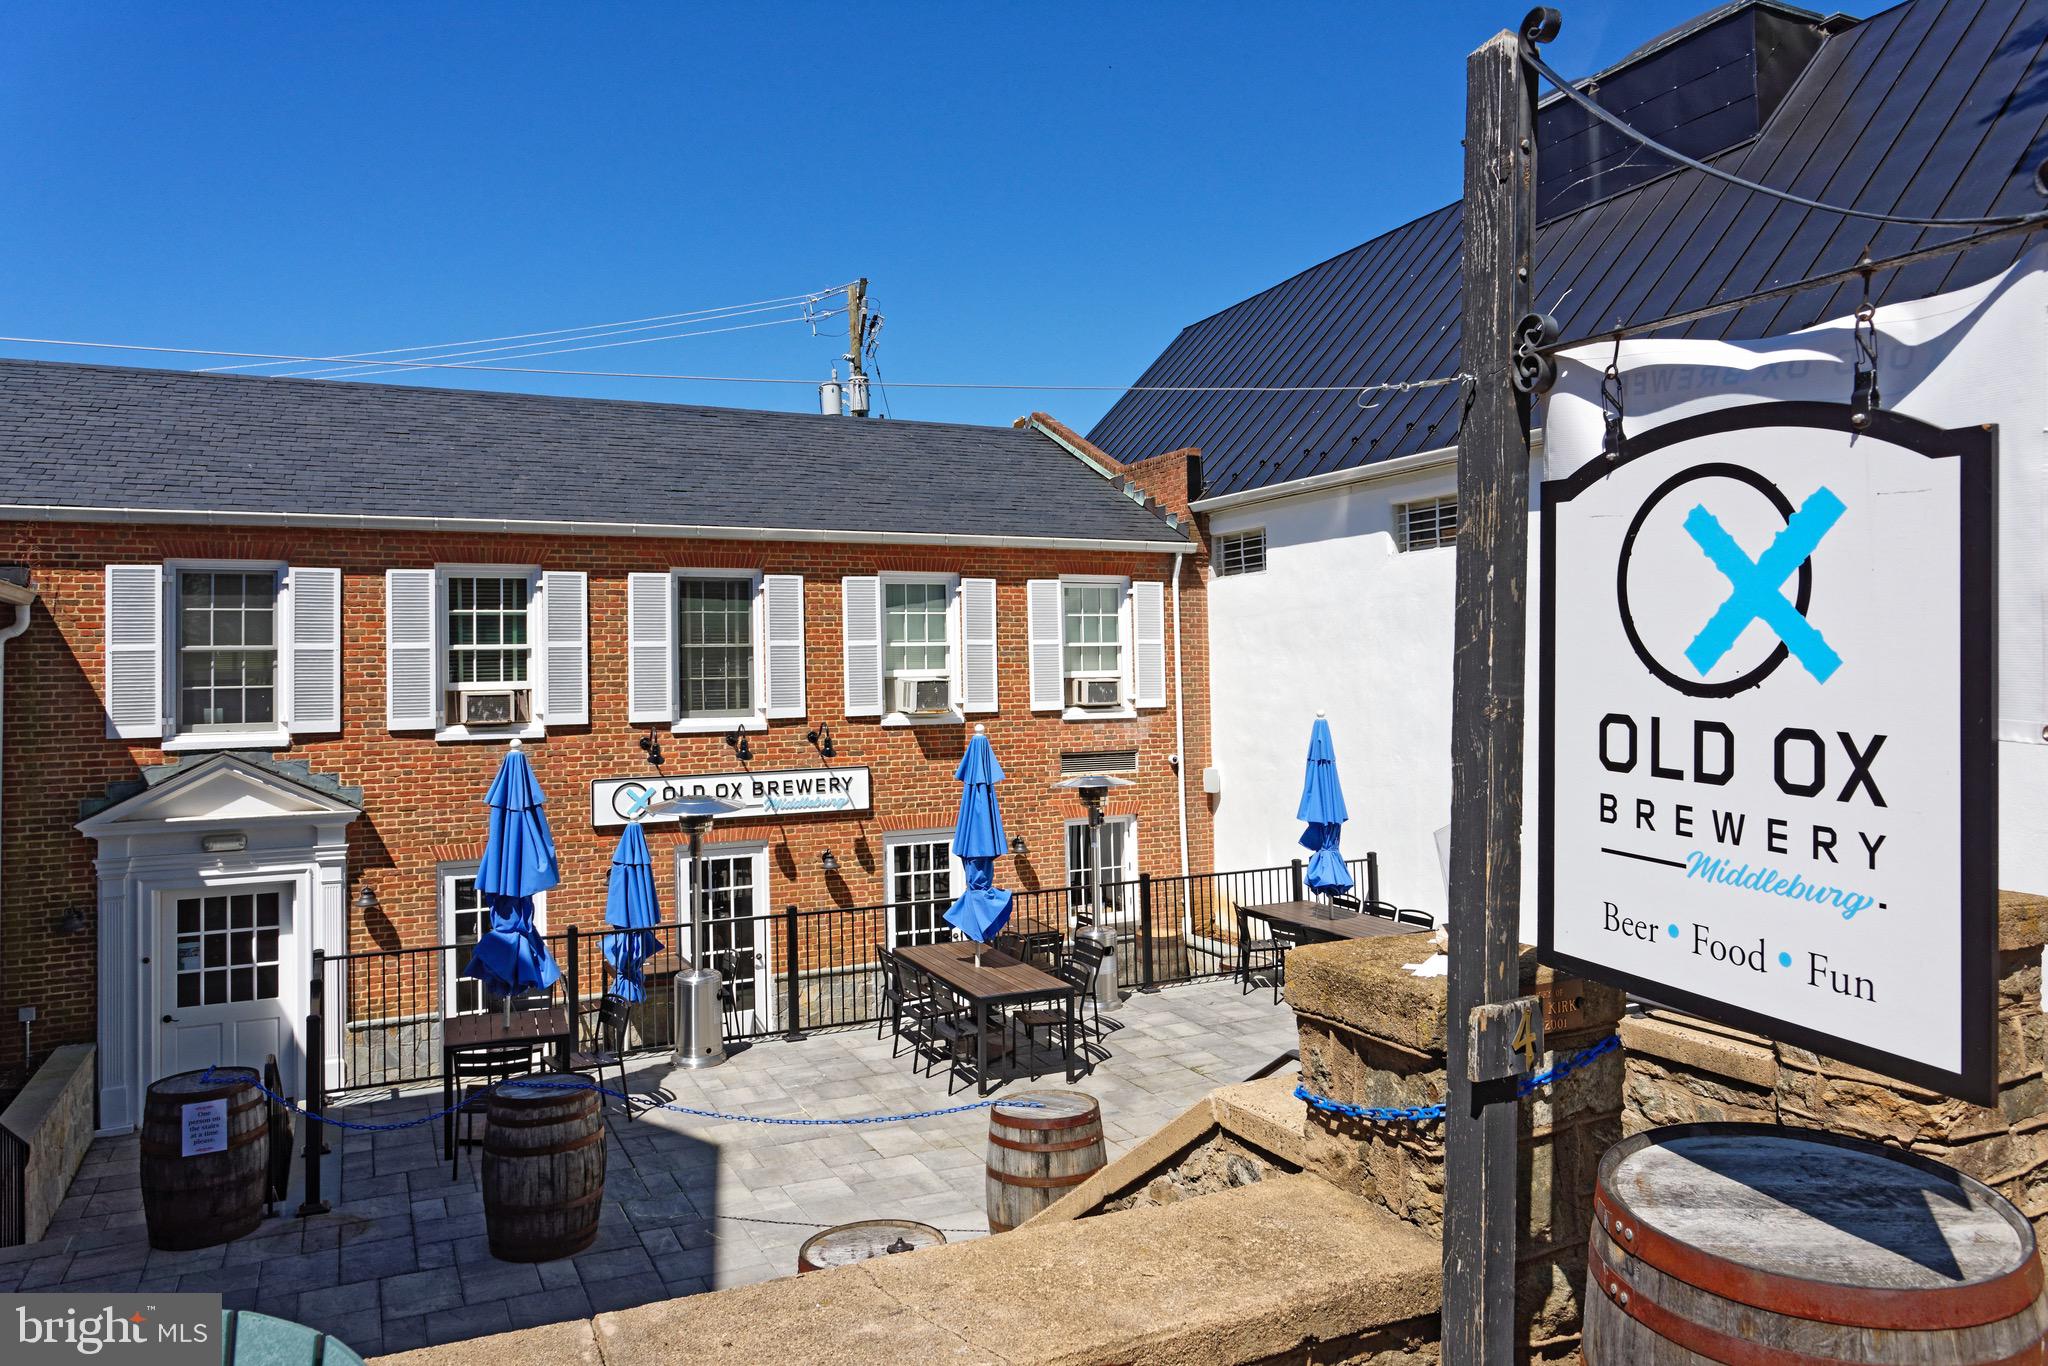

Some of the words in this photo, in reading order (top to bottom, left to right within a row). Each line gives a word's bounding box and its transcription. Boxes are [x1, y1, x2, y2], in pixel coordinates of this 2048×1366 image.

[716, 782, 742, 798] OX
[753, 776, 852, 796] BREWERY
[1599, 713, 1735, 786] OLD
[1774, 727, 1888, 808] OX
[1600, 792, 1887, 870] BREWERY
[1686, 850, 1875, 920] Middleburg
[1603, 901, 1659, 943] Beer
[1692, 923, 1768, 973] Food
[1808, 951, 1877, 1003] Fun
[1512, 1007, 1537, 1071] 4
[188, 1118, 210, 1126] person
